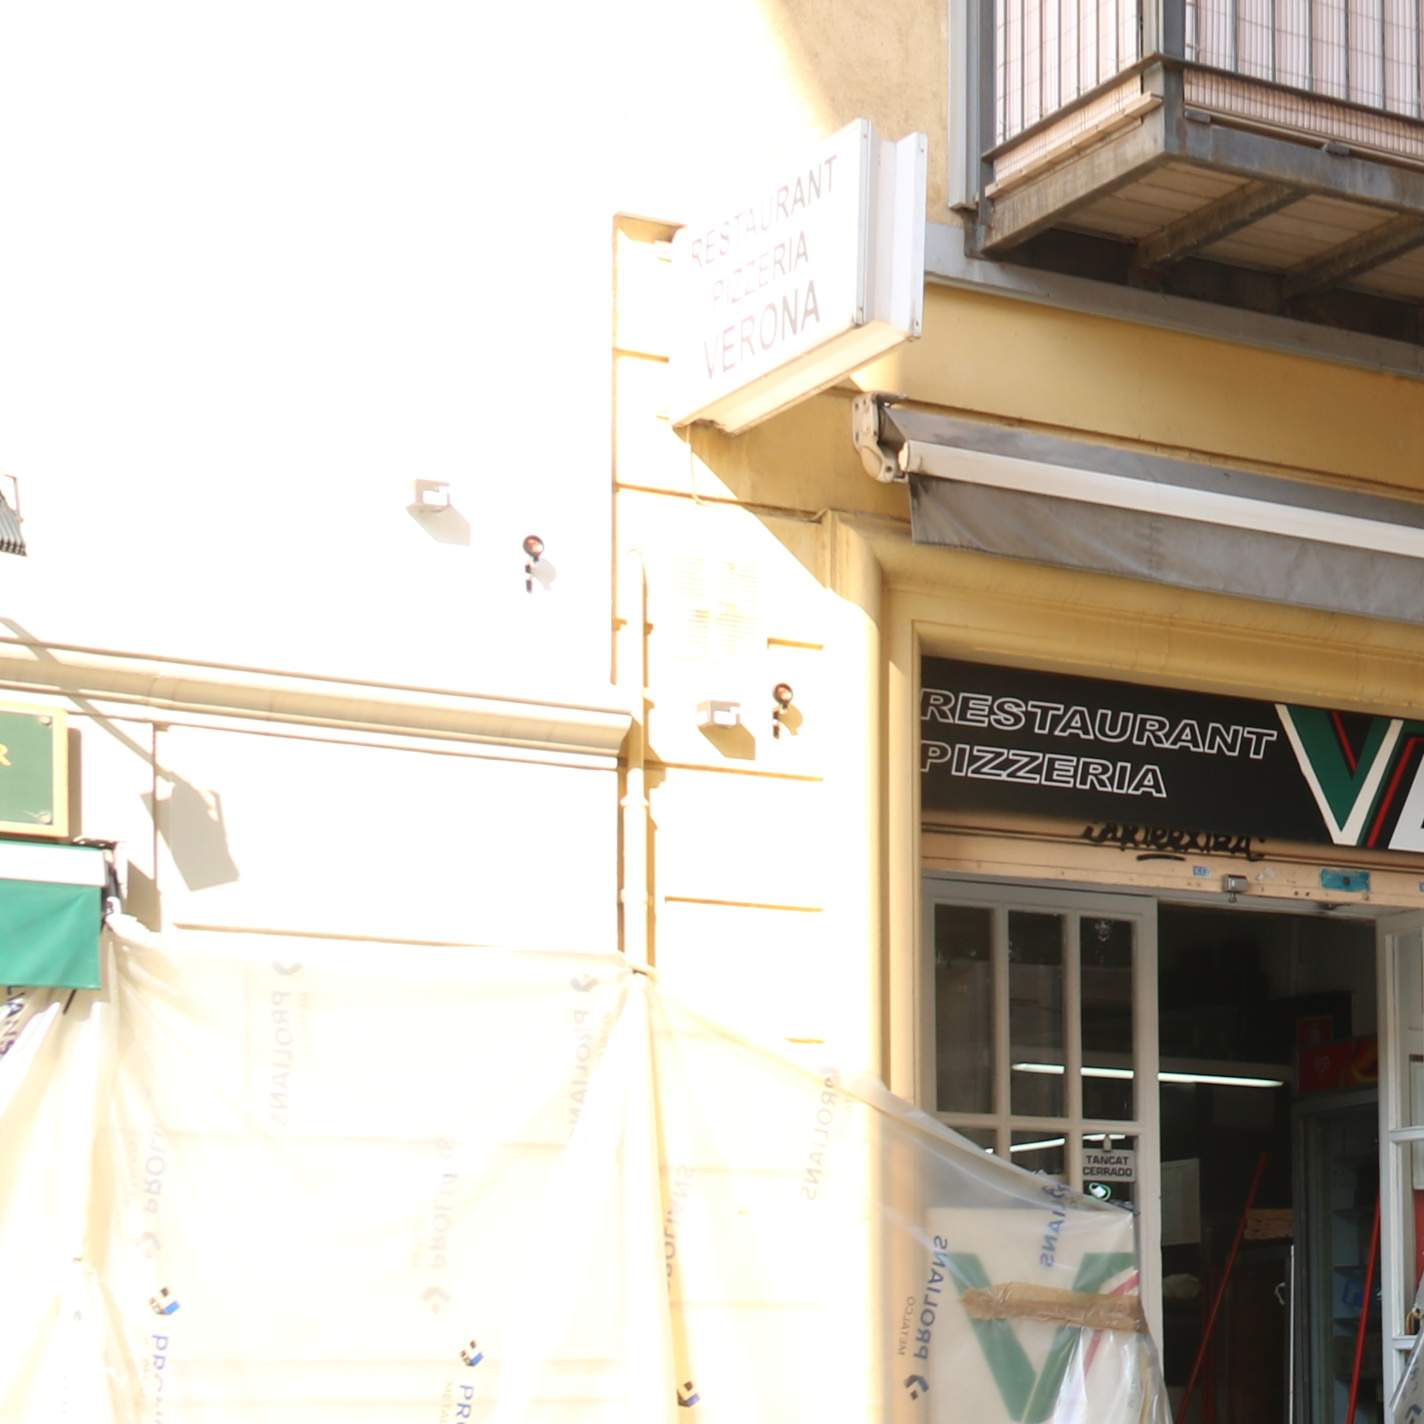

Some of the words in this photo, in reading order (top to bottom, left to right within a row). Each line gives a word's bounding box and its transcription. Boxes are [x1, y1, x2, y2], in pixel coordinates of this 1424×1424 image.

[690, 154, 838, 268] RESTAURANT
[712, 230, 809, 312] PIZZERIA
[703, 279, 821, 380] VERONA
[920, 688, 1277, 760] RESTAURANT
[920, 741, 1167, 798] PIZZERIA
[1082, 1166, 1133, 1177] CERRADO
[1086, 1155, 1128, 1166] TANCAT
